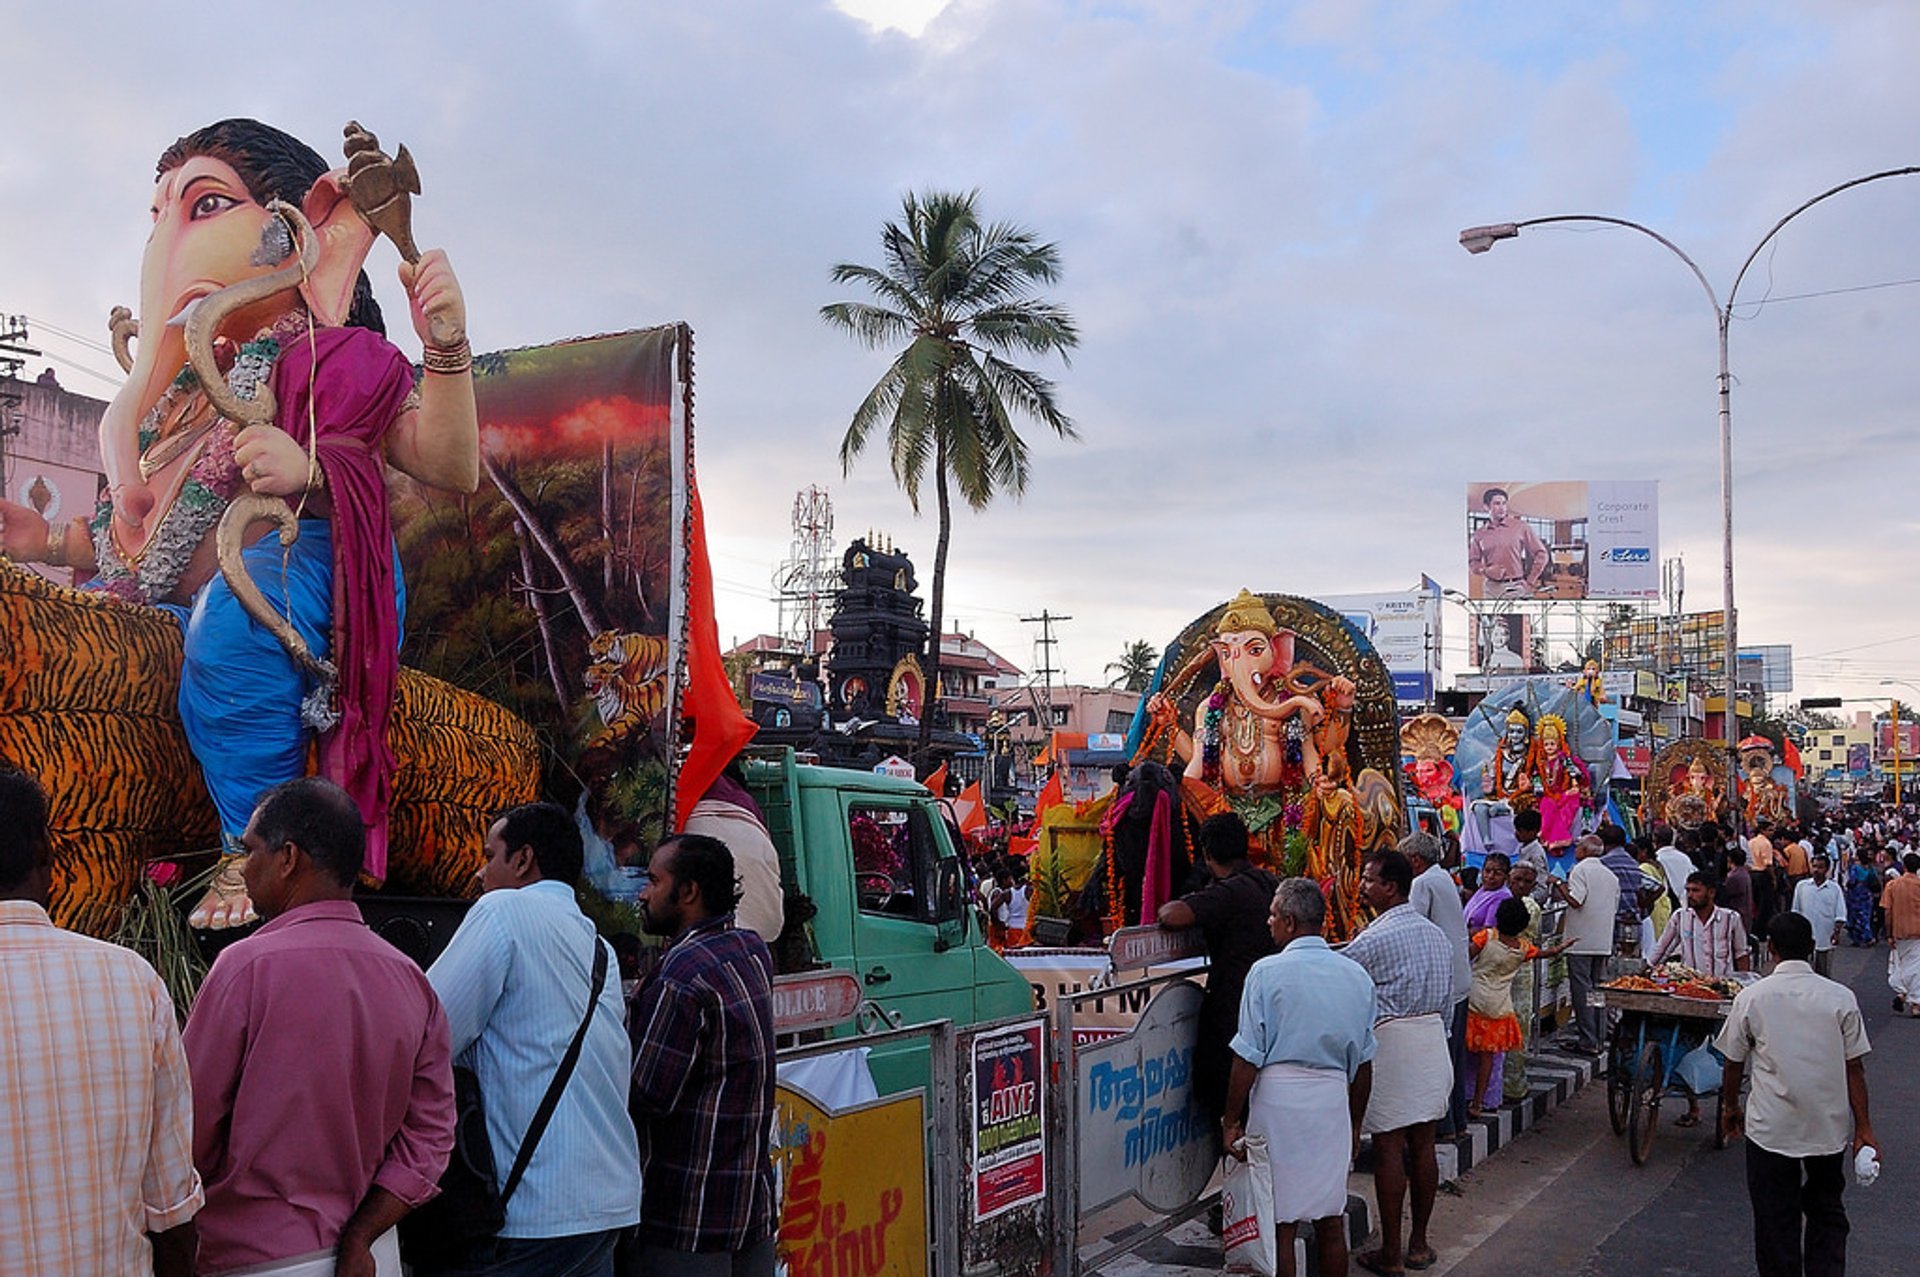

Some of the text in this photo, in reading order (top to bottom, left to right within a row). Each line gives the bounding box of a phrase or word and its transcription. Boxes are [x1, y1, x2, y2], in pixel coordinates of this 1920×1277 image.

[1597, 502, 1649, 513] Corporate
[1597, 514, 1624, 524] Crest
[773, 984, 827, 1018] OLICE
[990, 1080, 1035, 1125] AIYF
